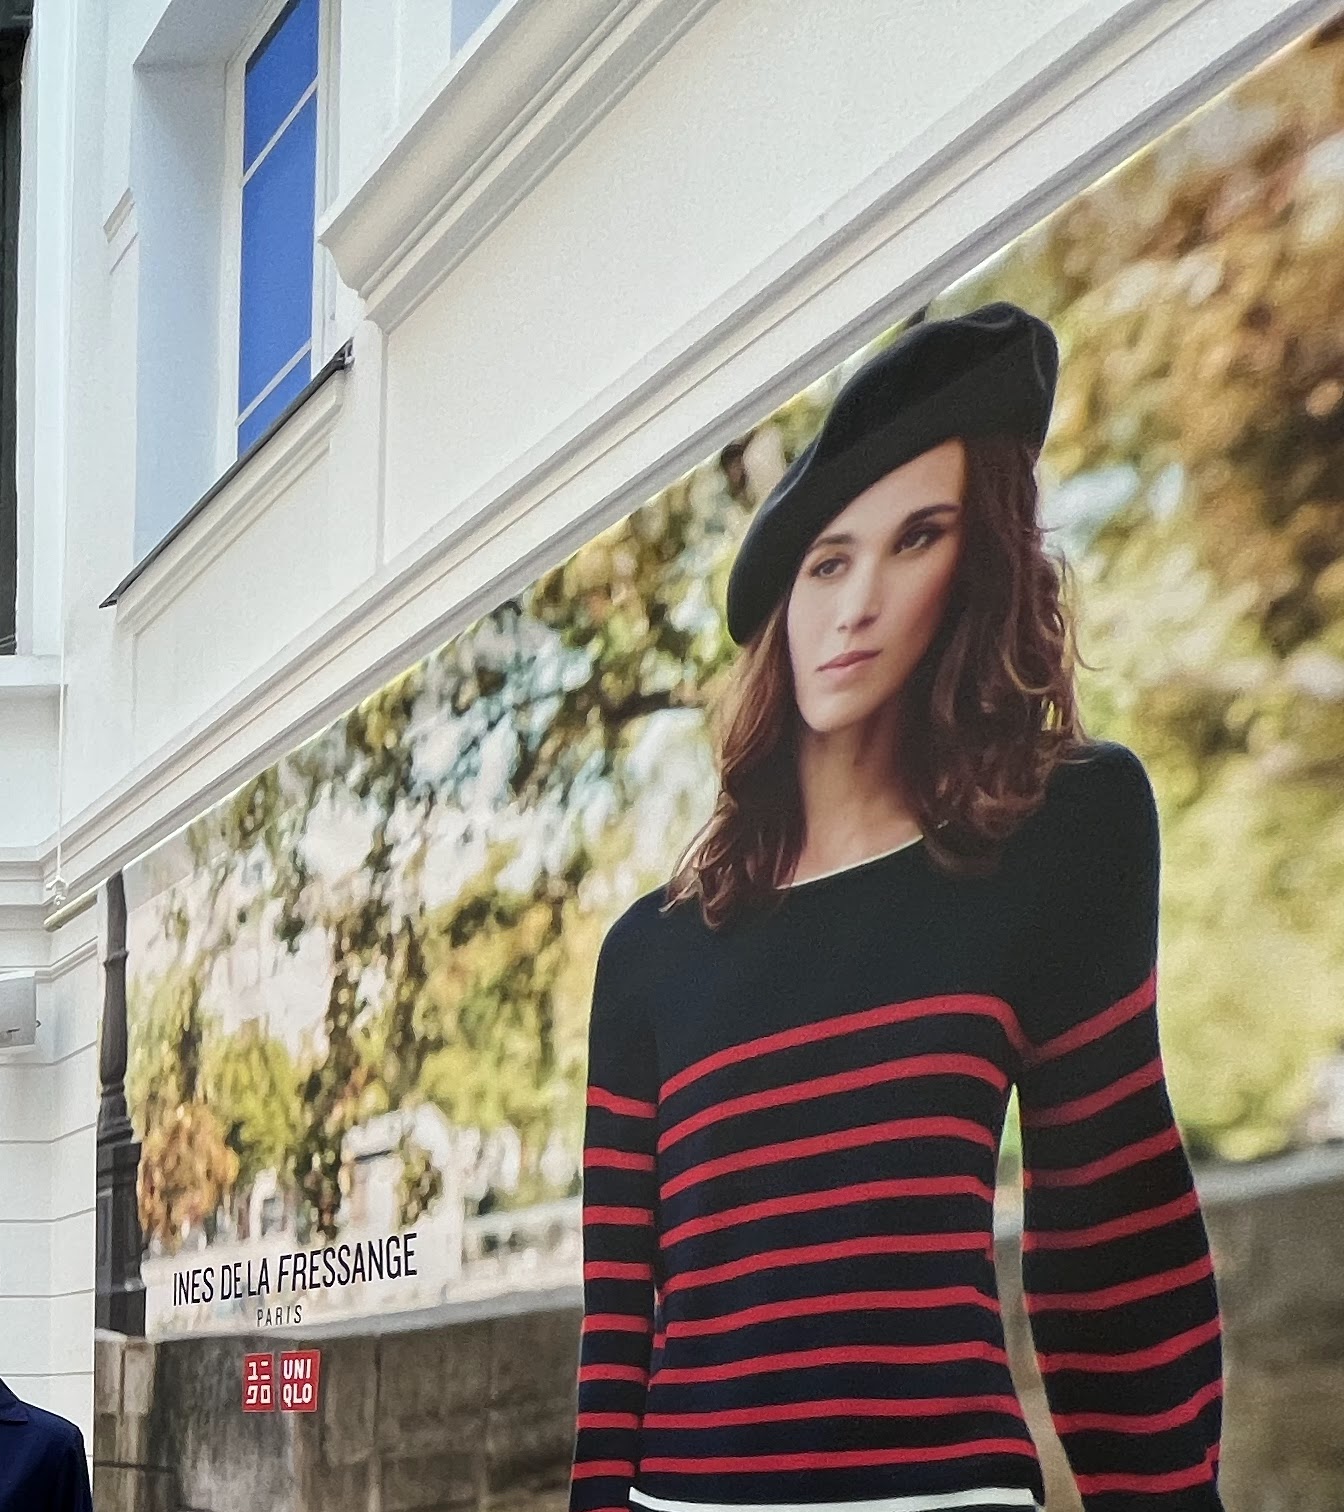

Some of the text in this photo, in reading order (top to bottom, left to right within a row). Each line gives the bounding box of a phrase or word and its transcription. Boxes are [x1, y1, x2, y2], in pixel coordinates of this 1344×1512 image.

[173, 1232, 418, 1307] INES DE LA FRESSANGE
[256, 1304, 302, 1327] PARIS
